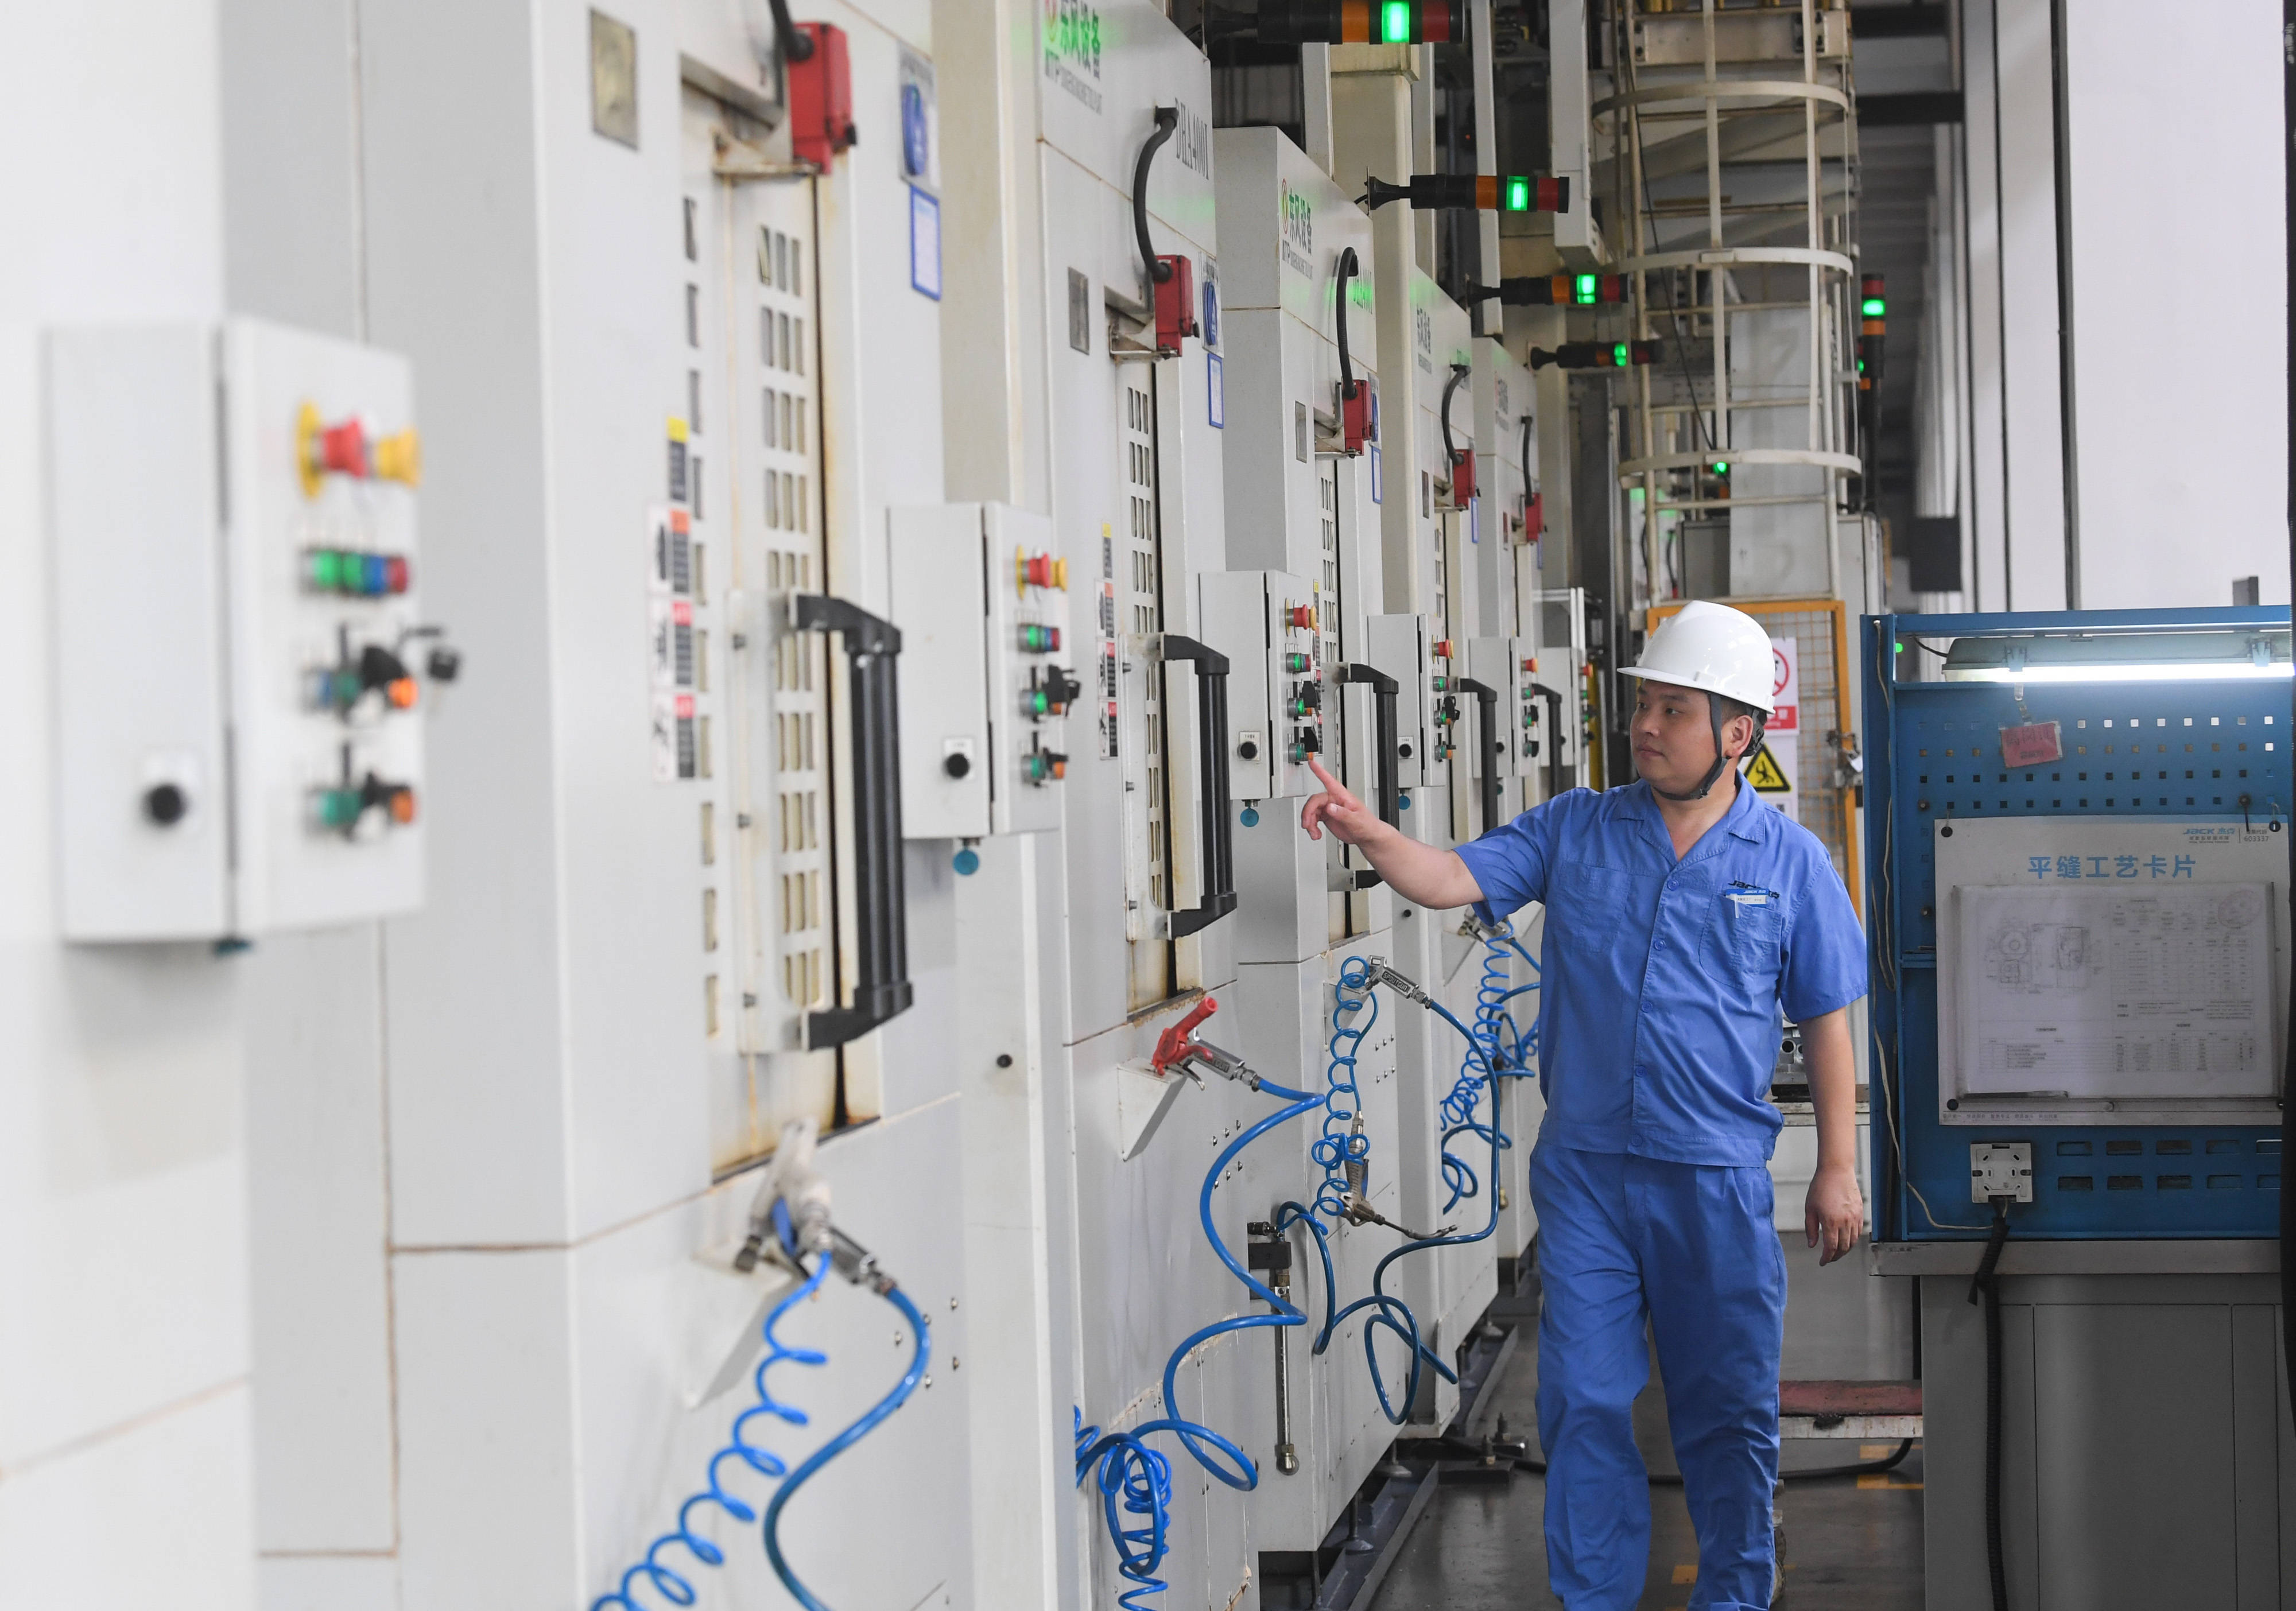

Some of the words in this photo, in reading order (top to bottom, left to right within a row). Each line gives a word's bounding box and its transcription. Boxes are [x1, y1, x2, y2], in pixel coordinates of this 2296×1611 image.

[2028, 855, 2196, 879] 平缝工艺卡片
[1383, 972, 1408, 992] SPOUTGUN
